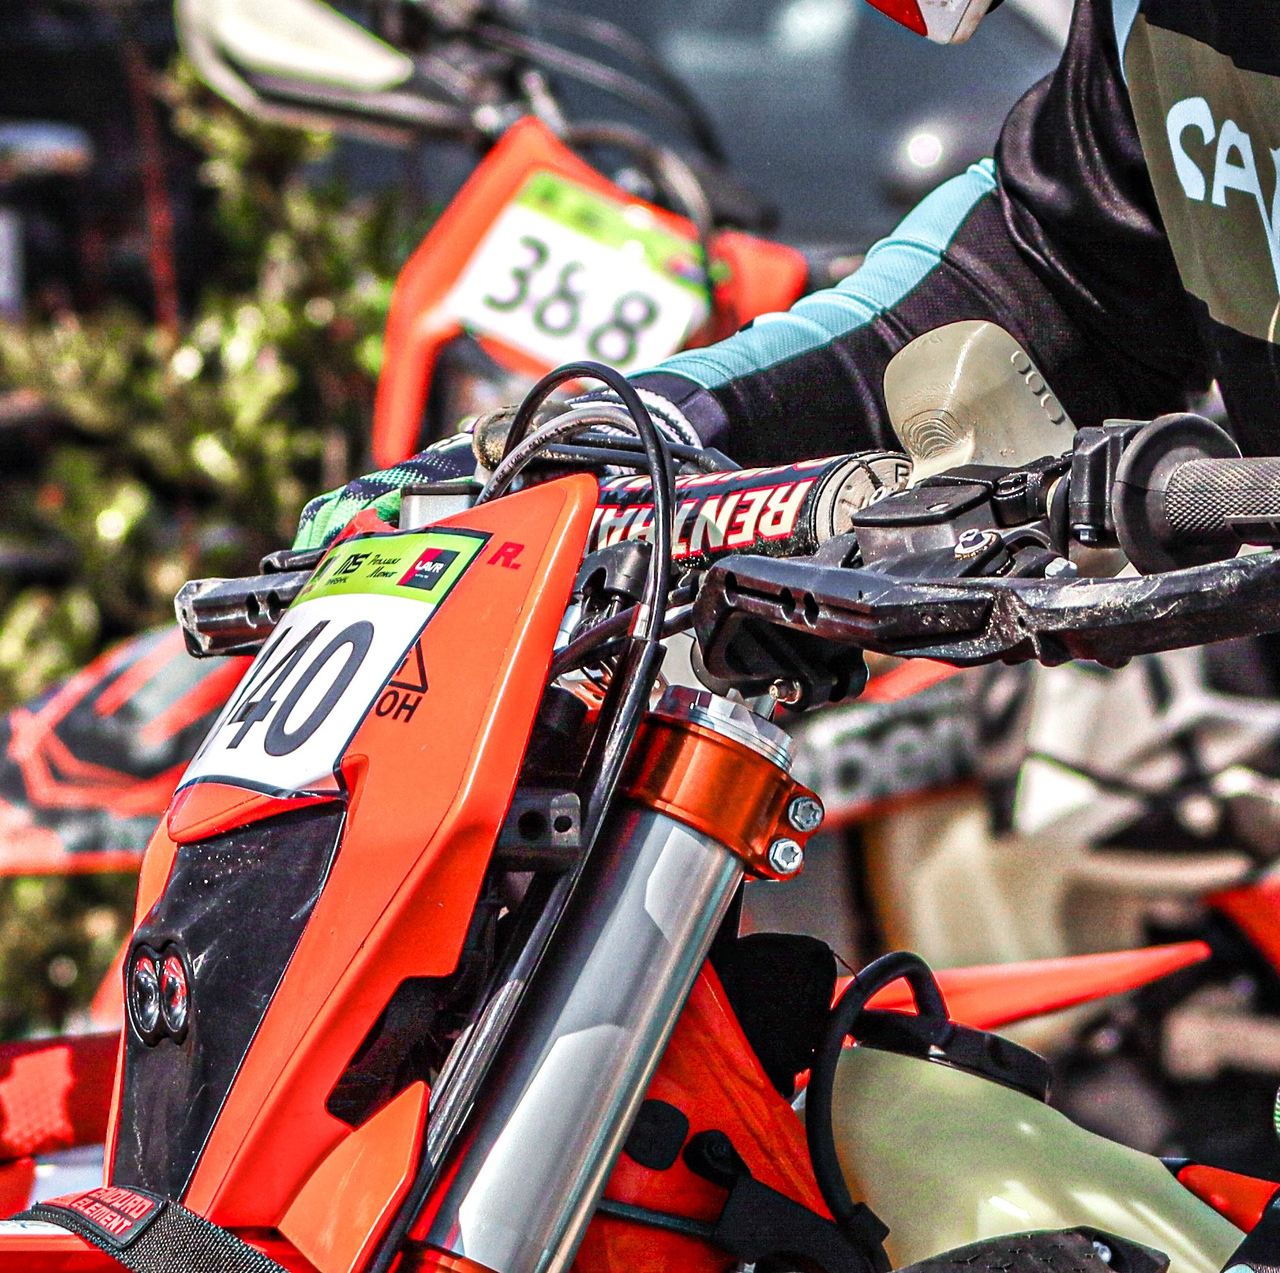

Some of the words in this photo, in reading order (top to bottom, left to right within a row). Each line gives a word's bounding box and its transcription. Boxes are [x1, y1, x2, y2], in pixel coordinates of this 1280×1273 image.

[590, 477, 817, 559] RENTHA
[414, 560, 445, 574] LAVR
[69, 1197, 134, 1236] ELEMENT
[86, 1187, 155, 1220] ENDURO
